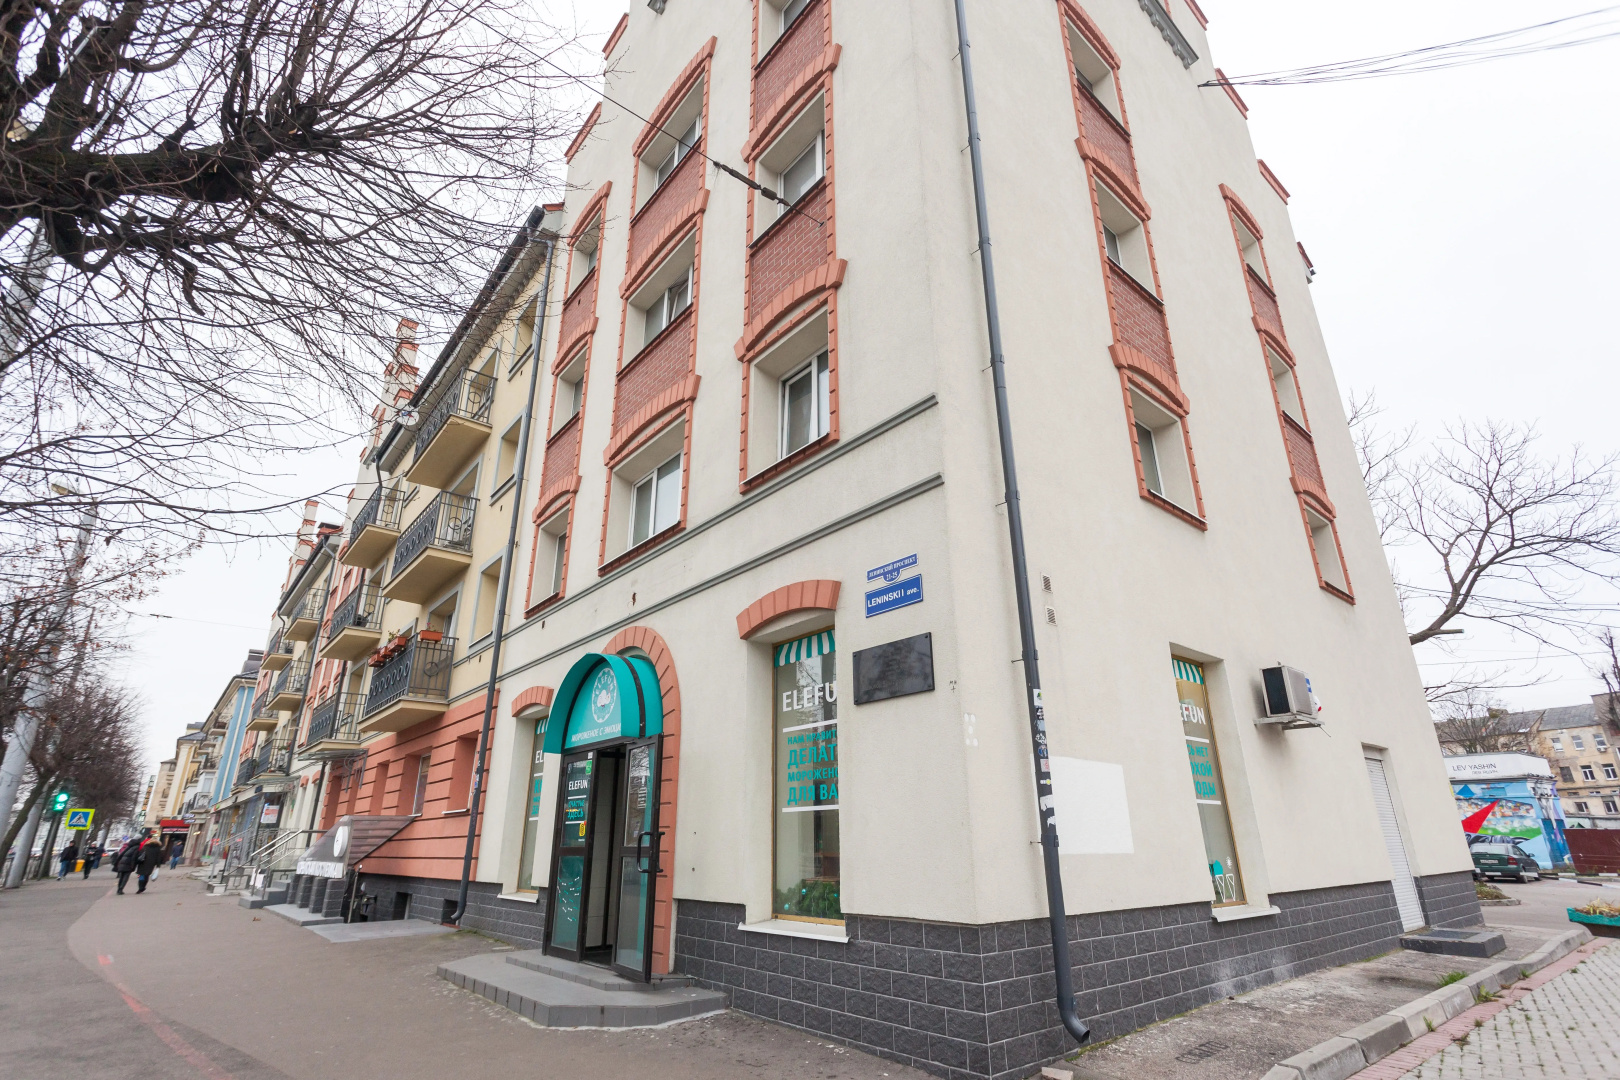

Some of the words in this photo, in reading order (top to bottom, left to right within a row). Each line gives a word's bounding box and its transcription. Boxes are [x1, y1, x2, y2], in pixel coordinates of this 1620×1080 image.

[906, 587, 920, 596] ave.
[1180, 703, 1206, 725] FUN
[787, 734, 805, 745] НАМ
[806, 729, 838, 743] НРАВИТ
[787, 743, 837, 770] ДЕЛАТ
[1195, 745, 1209, 757] НЕТ
[568, 779, 588, 791] ELEFUN
[1193, 780, 1217, 798] ОДЫ
[787, 785, 815, 806] ДЛЯ
